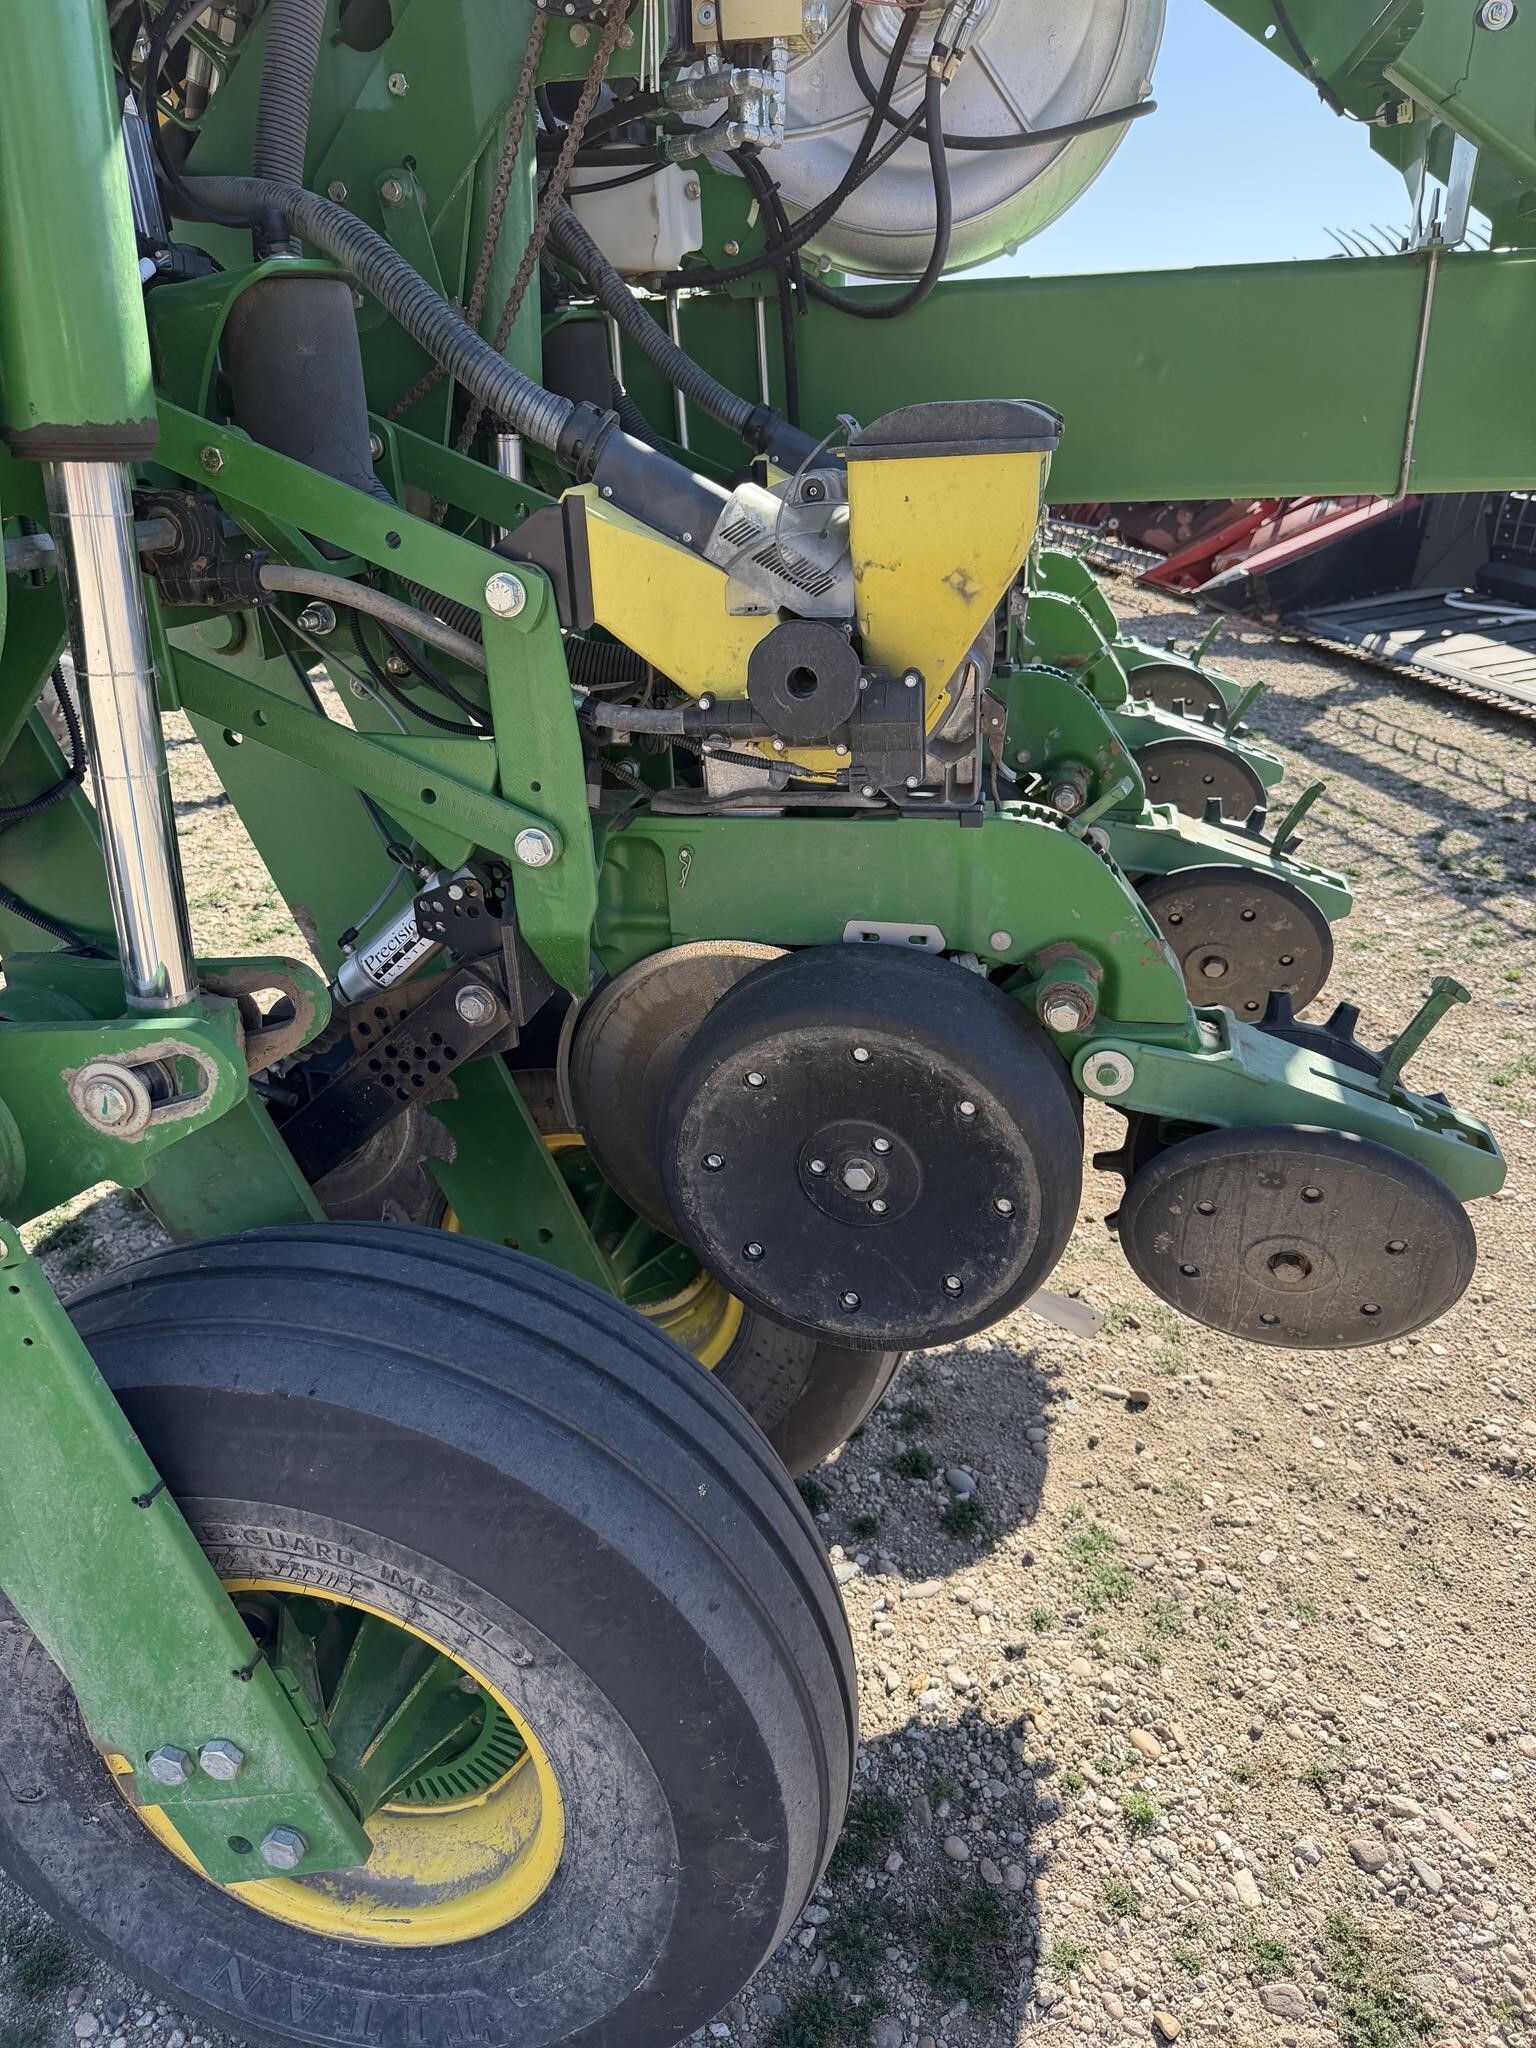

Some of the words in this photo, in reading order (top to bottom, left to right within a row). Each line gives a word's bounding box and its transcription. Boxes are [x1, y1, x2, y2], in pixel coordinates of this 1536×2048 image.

[364, 919, 417, 972] Precisio
[380, 941, 426, 985] PLANTI
[243, 1528, 356, 1565] GUARD
[203, 1955, 492, 2043] TITAN
